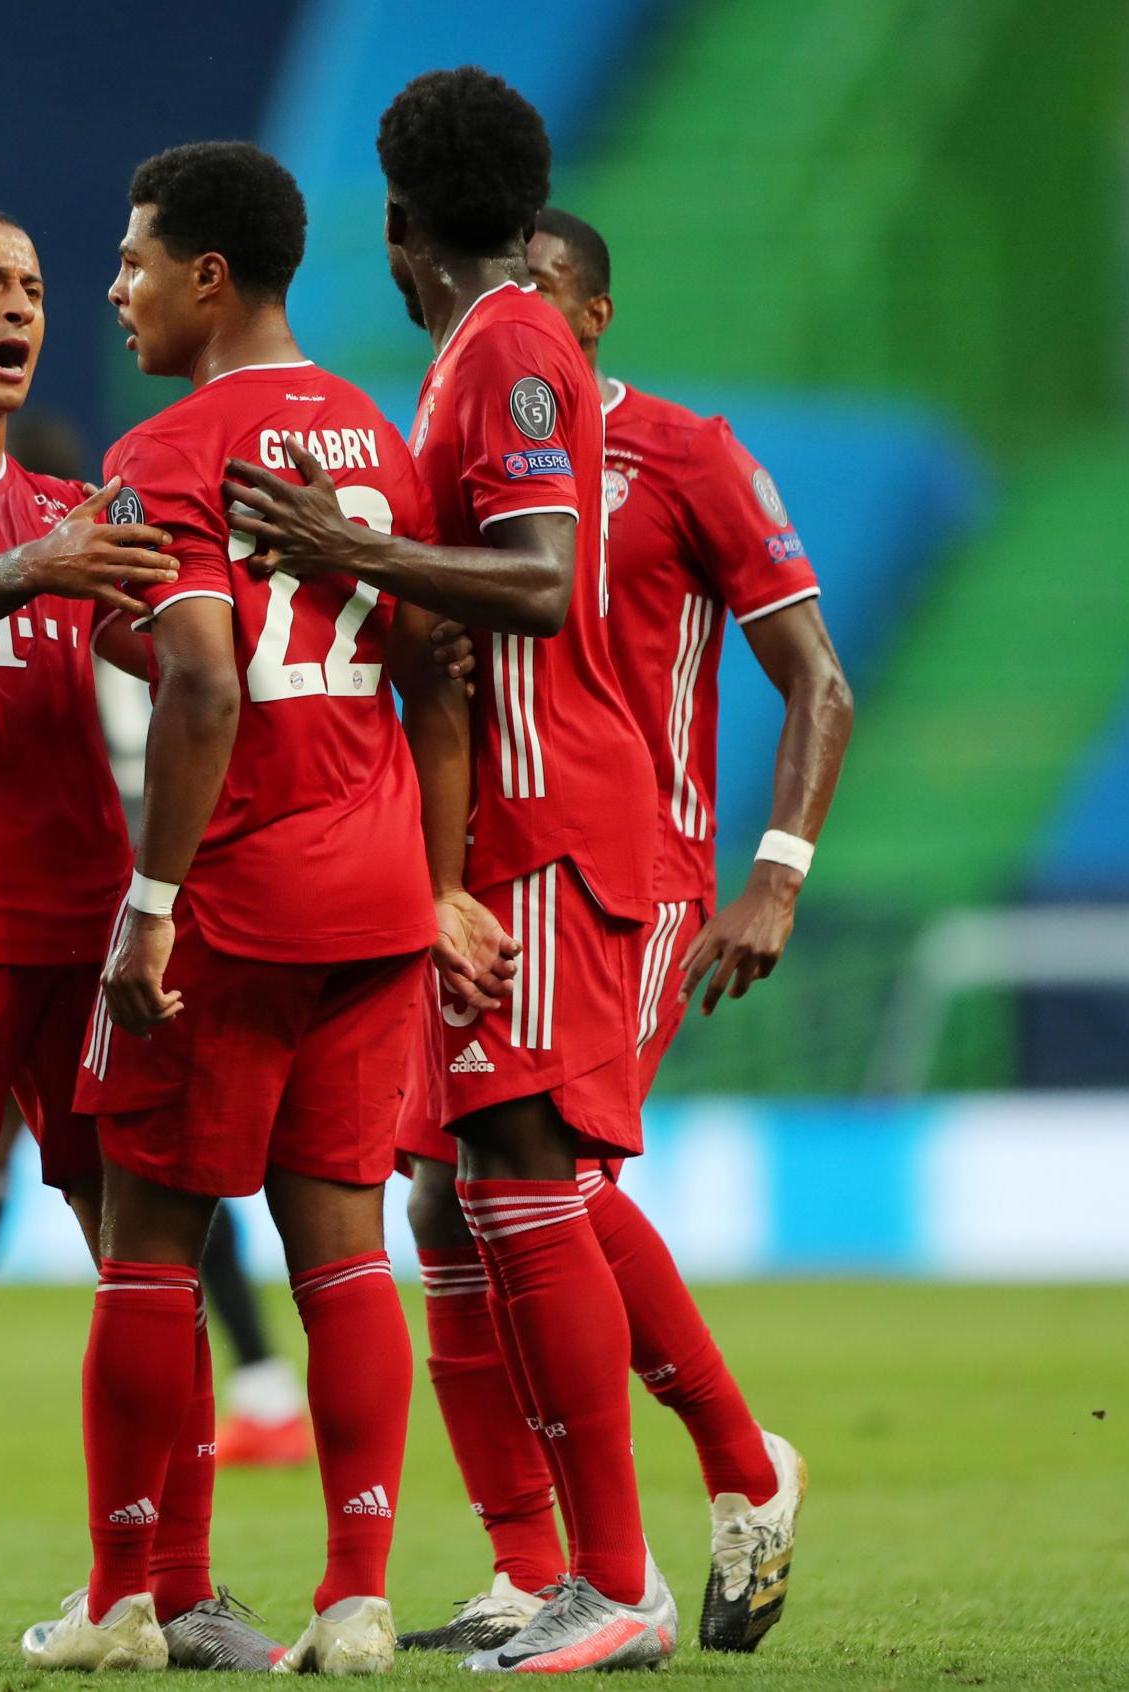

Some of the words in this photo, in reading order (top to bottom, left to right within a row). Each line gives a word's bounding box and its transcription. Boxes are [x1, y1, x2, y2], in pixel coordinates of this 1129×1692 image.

[532, 406, 543, 423] 5
[228, 486, 393, 702] 22
[449, 1060, 495, 1073] adidas
[197, 1442, 216, 1457] FC
[109, 1511, 159, 1525] adidas
[343, 1503, 392, 1518] adidas
